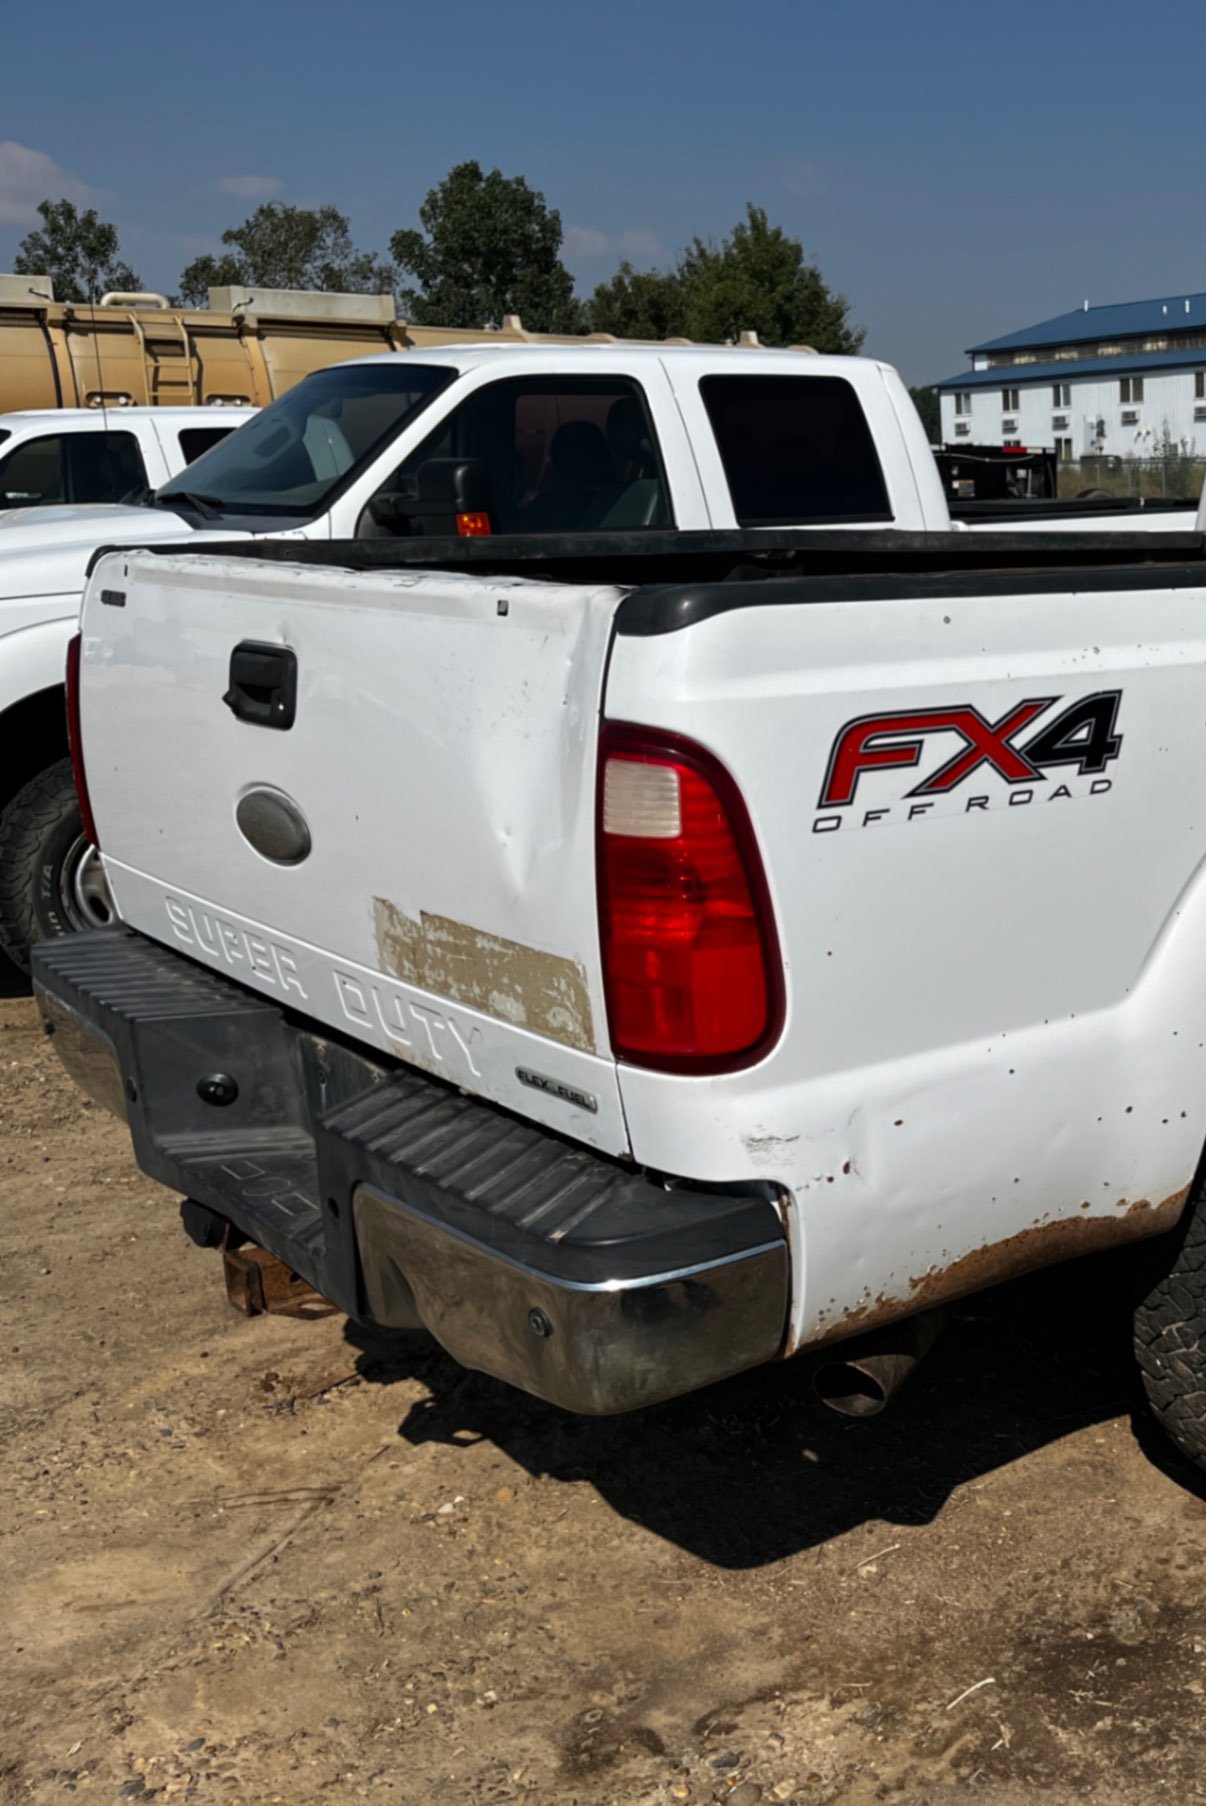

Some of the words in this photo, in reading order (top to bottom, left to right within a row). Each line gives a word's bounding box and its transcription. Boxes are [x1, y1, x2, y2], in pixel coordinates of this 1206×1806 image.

[811, 802, 935, 834] OFF
[964, 779, 1113, 813] ROAD
[816, 689, 1124, 811] FX4
[164, 895, 308, 1000] SUPER
[332, 969, 482, 1078] DUTY
